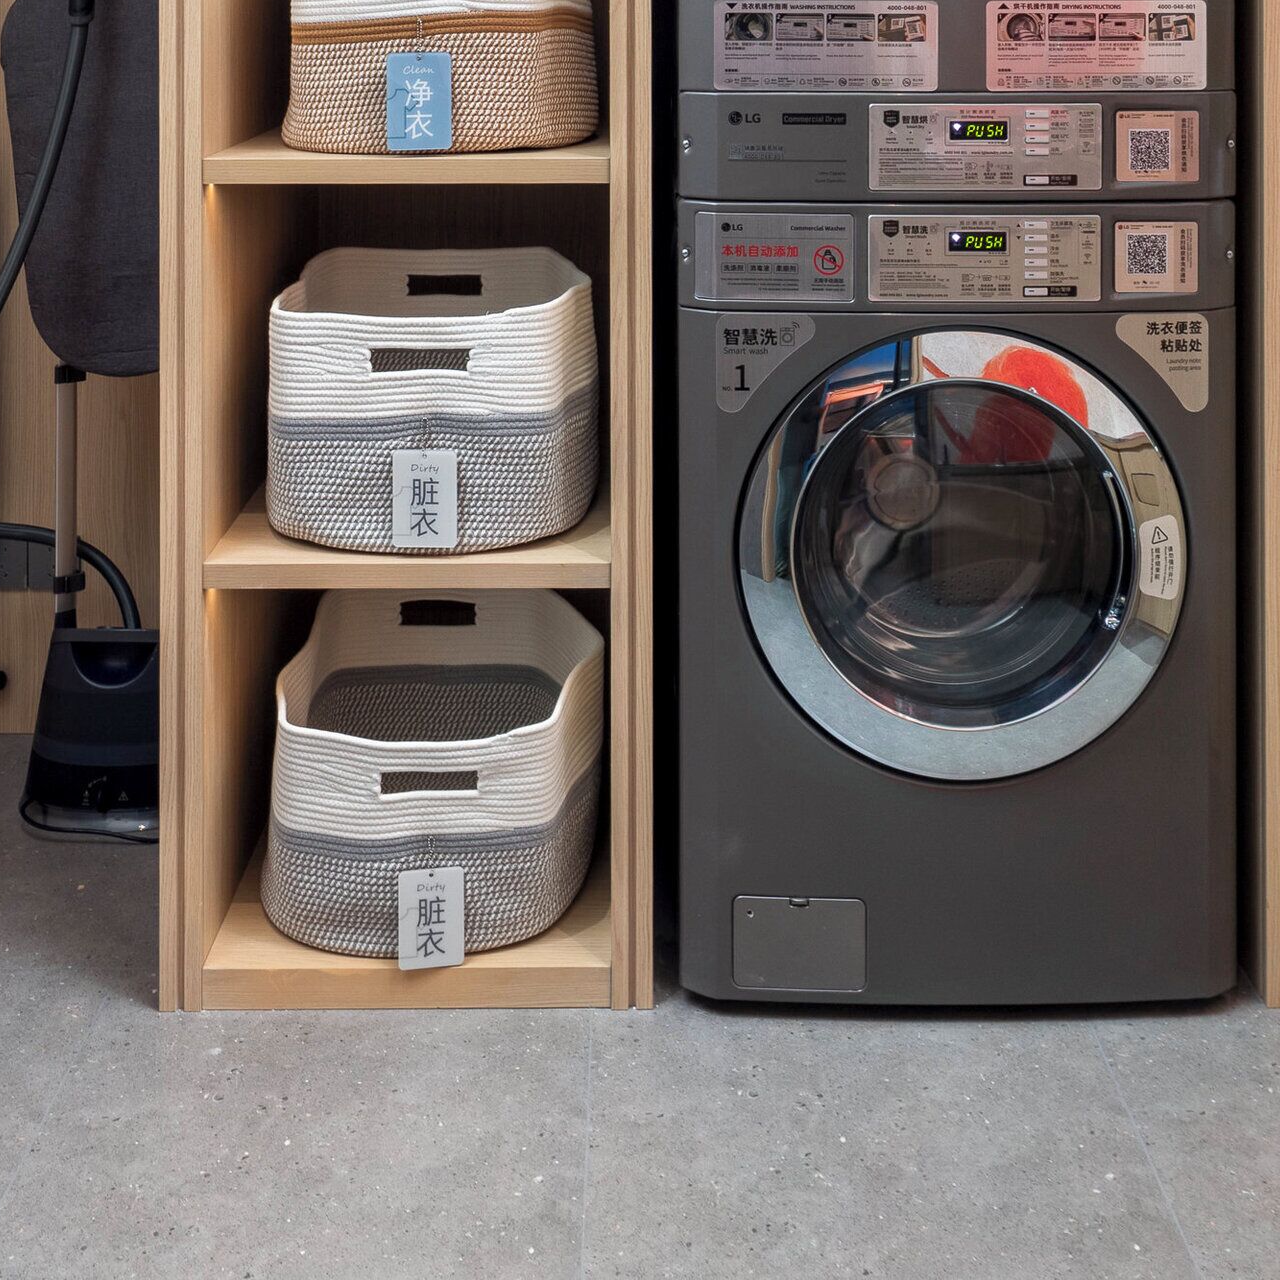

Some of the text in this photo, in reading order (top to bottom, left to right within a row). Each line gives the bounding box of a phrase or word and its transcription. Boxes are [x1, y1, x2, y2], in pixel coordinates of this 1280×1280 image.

[403, 65, 435, 75] Clean
[404, 78, 433, 140] 净衣
[745, 113, 761, 123] LG
[902, 115, 928, 124] 智慧烘
[966, 125, 1004, 138] PUSH
[902, 225, 928, 234] 智慧洗
[965, 236, 1003, 249] PUSH
[721, 245, 799, 258] 本机自动添加
[1146, 321, 1202, 335] 洗衣便签
[723, 328, 778, 346] 智慧洗
[1160, 339, 1202, 352] 粘贴处
[735, 364, 750, 391] 1
[410, 464, 440, 474] Dirty
[410, 477, 439, 537] 脏衣
[416, 883, 446, 893] Dirty
[417, 896, 446, 958] 脏衣
